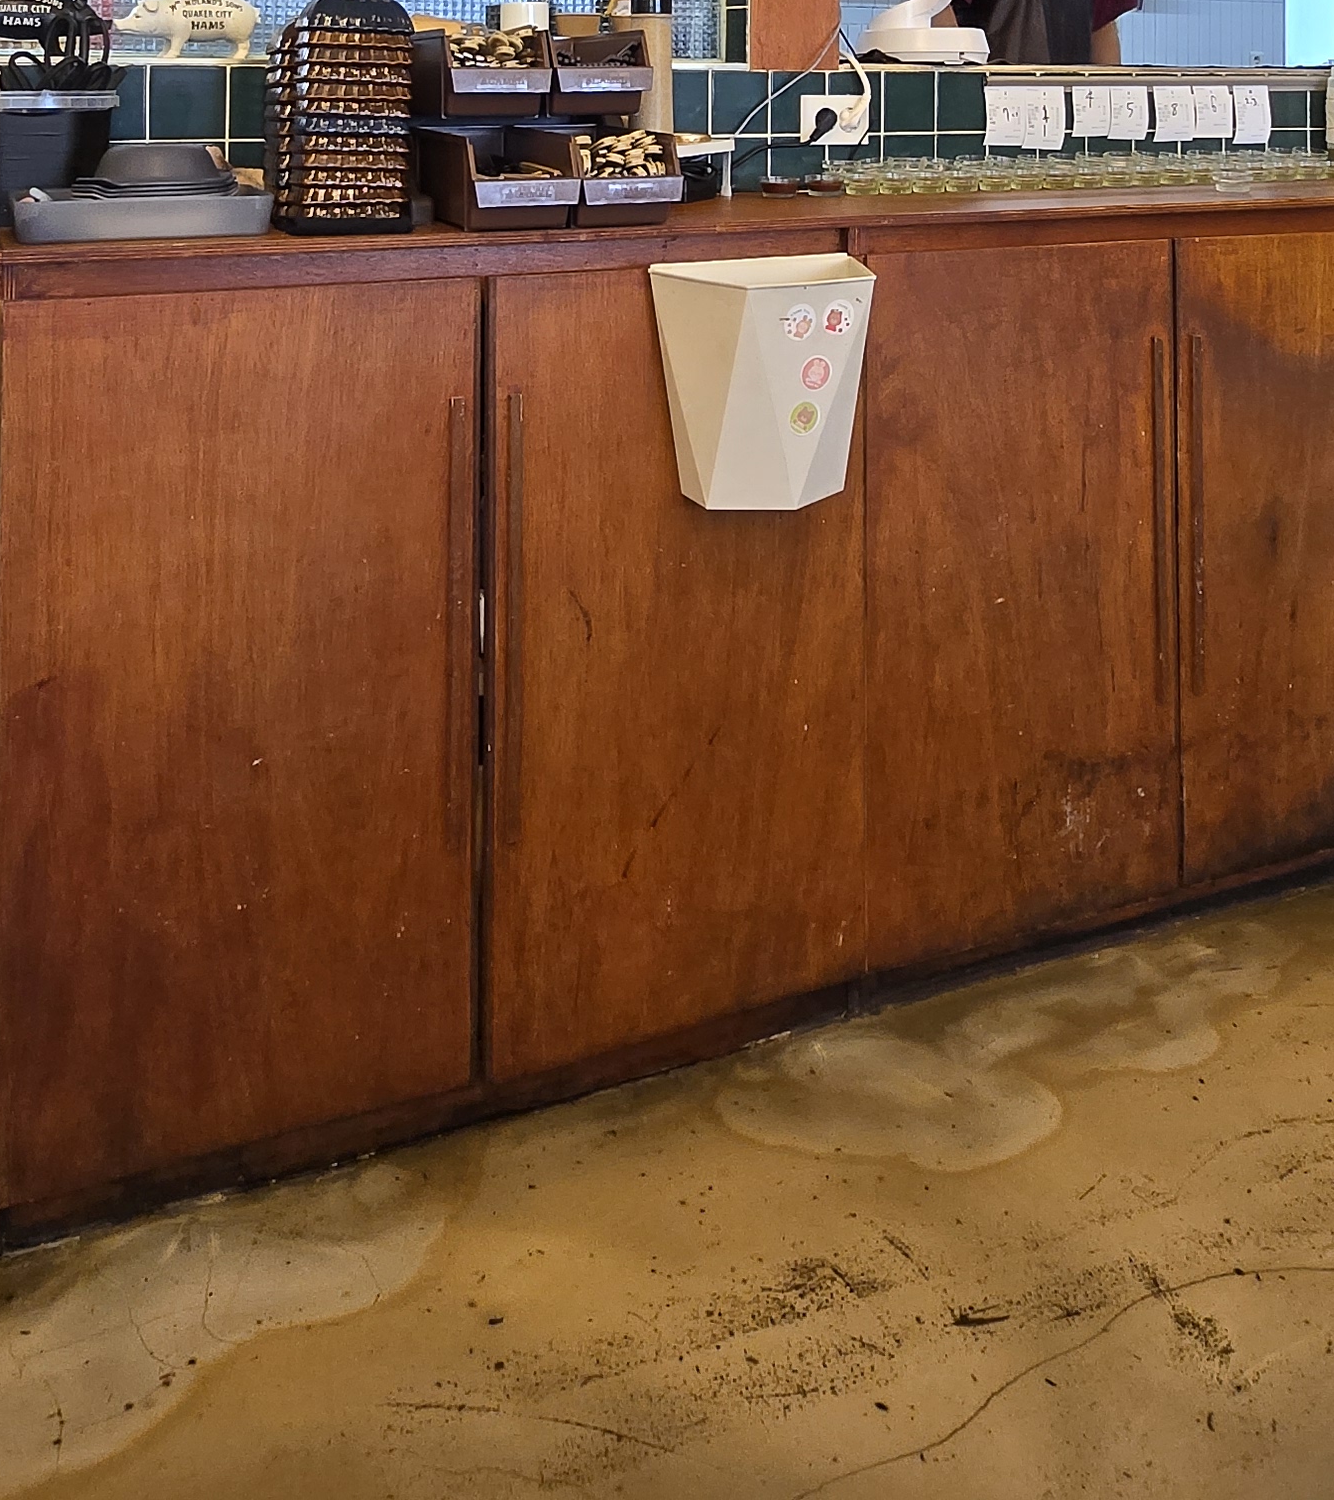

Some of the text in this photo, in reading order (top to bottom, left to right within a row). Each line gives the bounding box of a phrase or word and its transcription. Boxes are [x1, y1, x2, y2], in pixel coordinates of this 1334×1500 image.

[30, 4, 52, 13] CITY
[182, 9, 233, 19] QUAKER CITY
[3, 15, 42, 27] HAMS
[191, 20, 225, 30] HAMS
